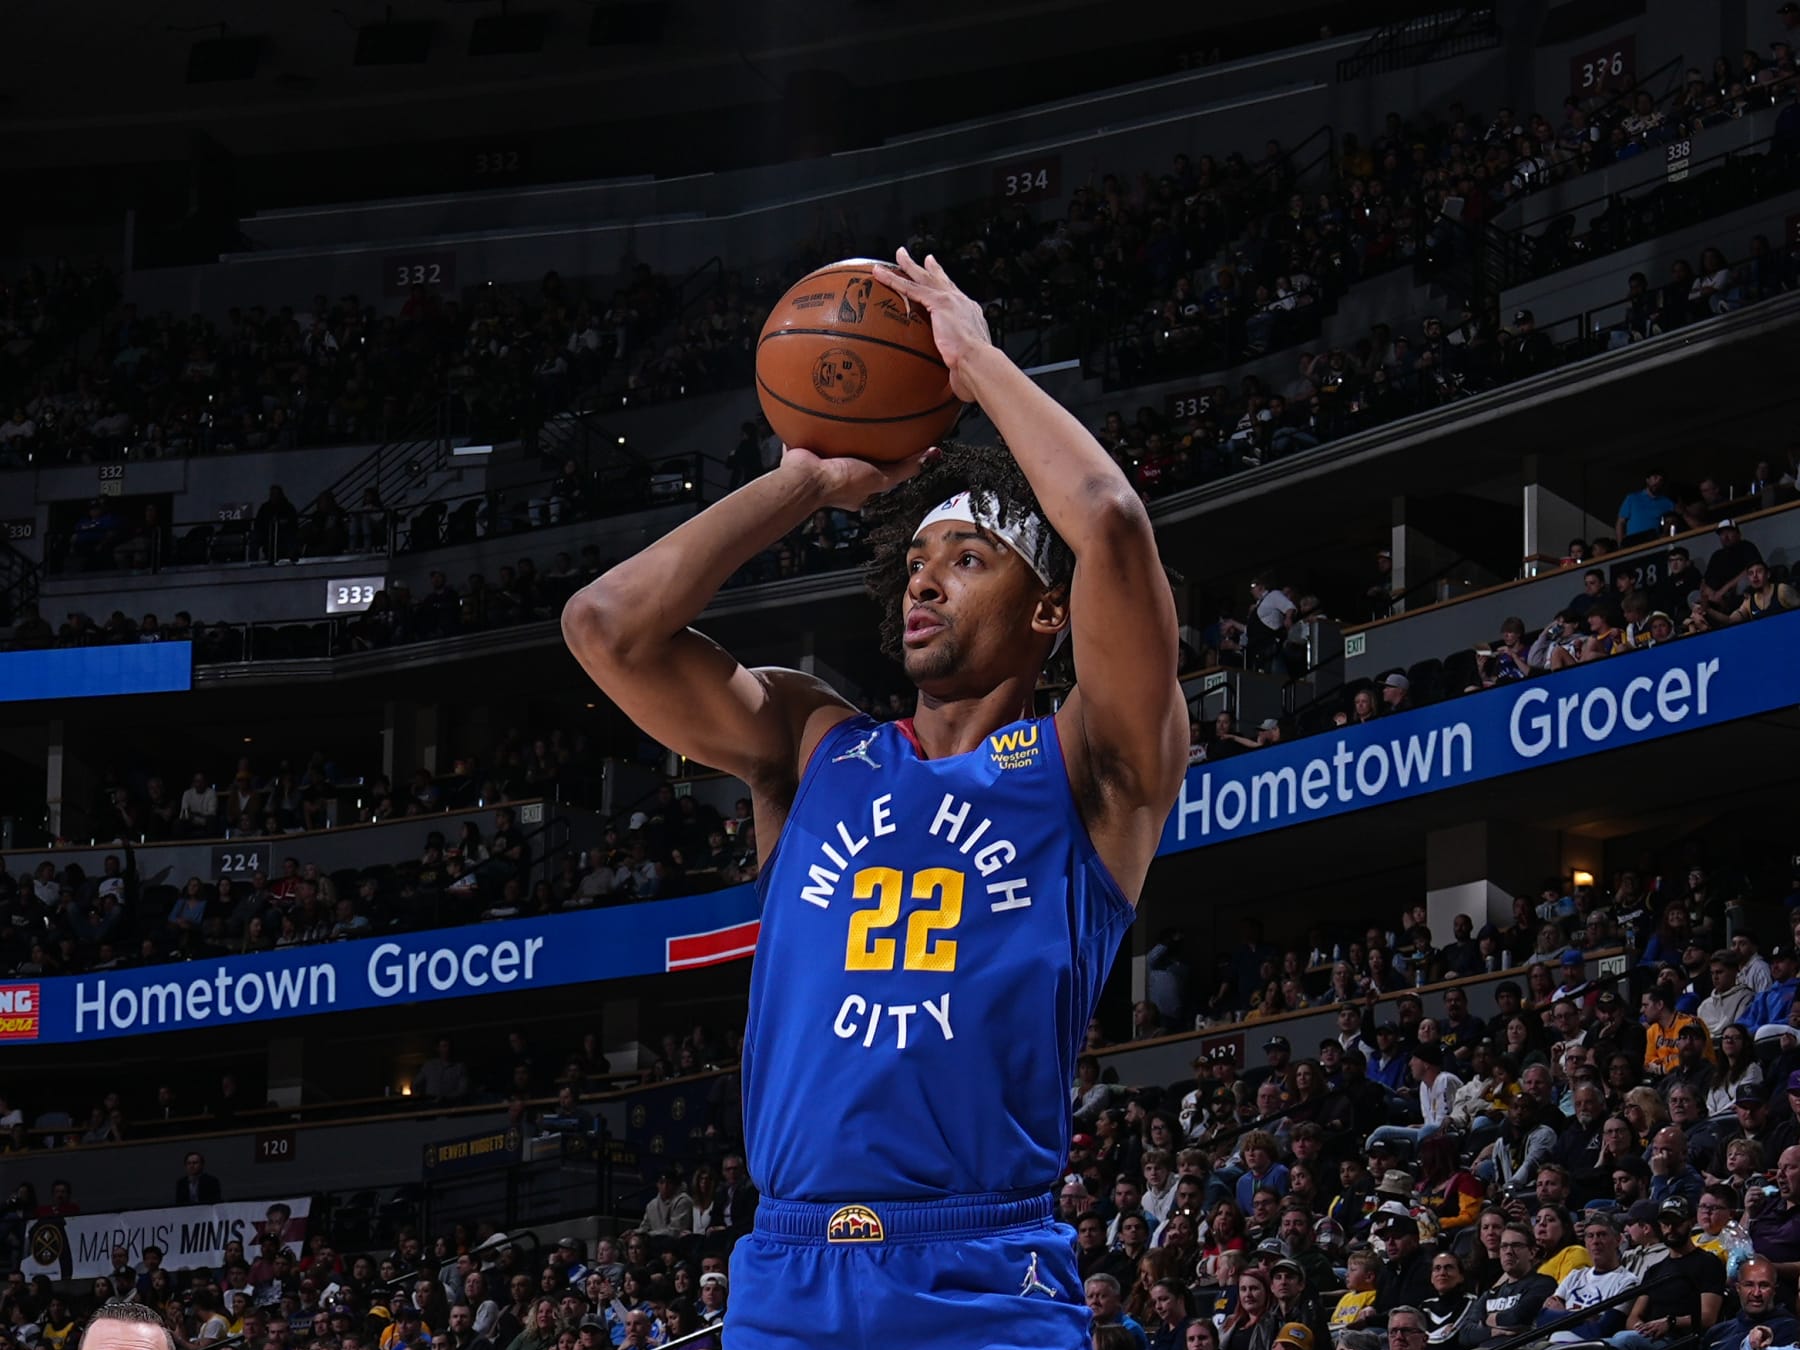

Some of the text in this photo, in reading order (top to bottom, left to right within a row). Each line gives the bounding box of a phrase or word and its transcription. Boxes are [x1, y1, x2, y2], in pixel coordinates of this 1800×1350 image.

[1667, 141, 1691, 161] 338
[1005, 168, 1049, 197] 334
[396, 263, 441, 287] 332
[1174, 395, 1211, 419] 335
[100, 464, 122, 480] 332
[10, 524, 32, 539] 330
[337, 586, 374, 604] 333
[1346, 636, 1364, 654] EXIT
[990, 725, 1037, 752] WU
[1177, 657, 1720, 840] Hometown Grocer
[990, 747, 1039, 762] Western
[999, 758, 1032, 770] Union
[523, 805, 542, 823] EXIT
[220, 853, 259, 873] 224
[801, 792, 1032, 912] MILE HIGH
[844, 866, 965, 972] 22
[75, 936, 543, 1033] Hometown Grocer
[0, 990, 33, 1013] NG
[833, 992, 955, 1049] CITY
[263, 1138, 288, 1155] 120
[181, 1218, 246, 1254] MINIS
